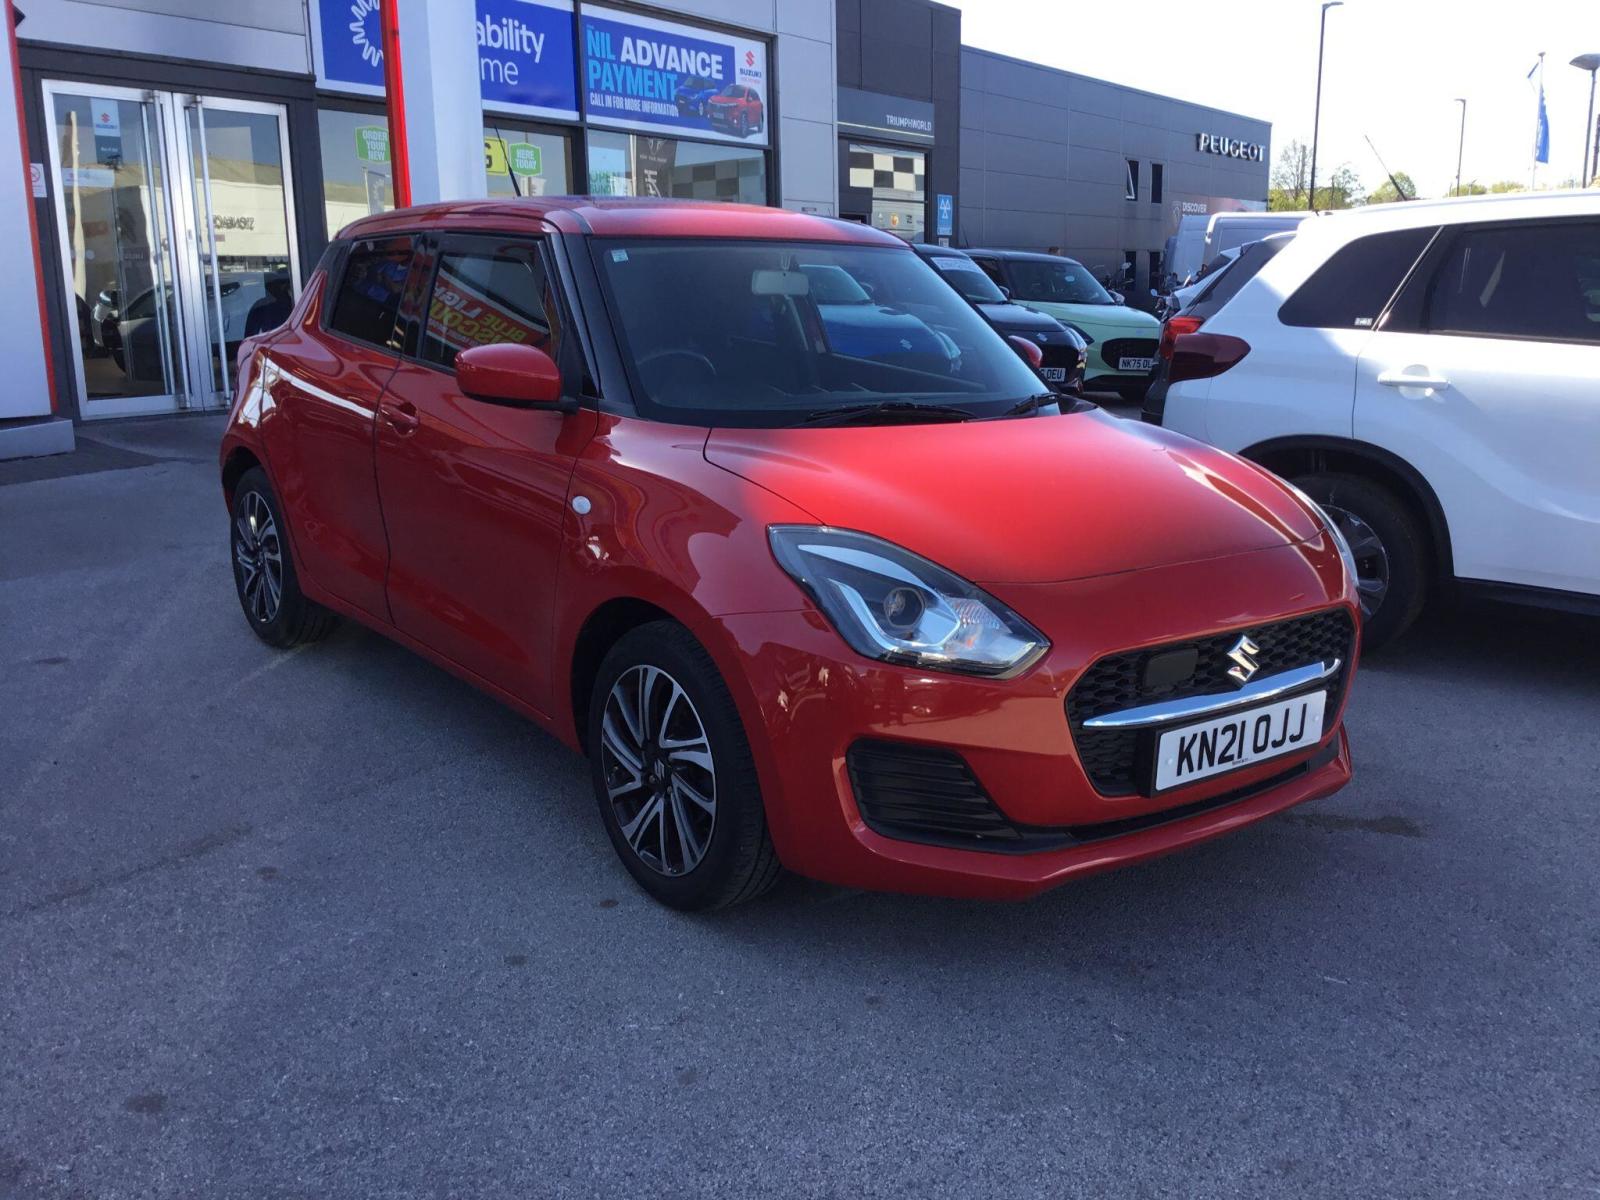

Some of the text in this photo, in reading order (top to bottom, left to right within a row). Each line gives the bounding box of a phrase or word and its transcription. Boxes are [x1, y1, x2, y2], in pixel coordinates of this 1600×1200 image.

[586, 29, 723, 80] NIL ADVANCE
[588, 59, 678, 102] PAYMENT
[589, 92, 679, 118] CALL IN FOR MORE INFORMATION
[362, 130, 388, 141] ORDER
[366, 139, 386, 151] YOUR
[1199, 132, 1265, 162] PEUGEOT
[367, 150, 385, 161] NEW
[516, 149, 535, 160] HERE
[1182, 202, 1207, 213] DISCOVER
[1121, 359, 1141, 368] NK75
[1176, 703, 1307, 777] KN21 OJJ
